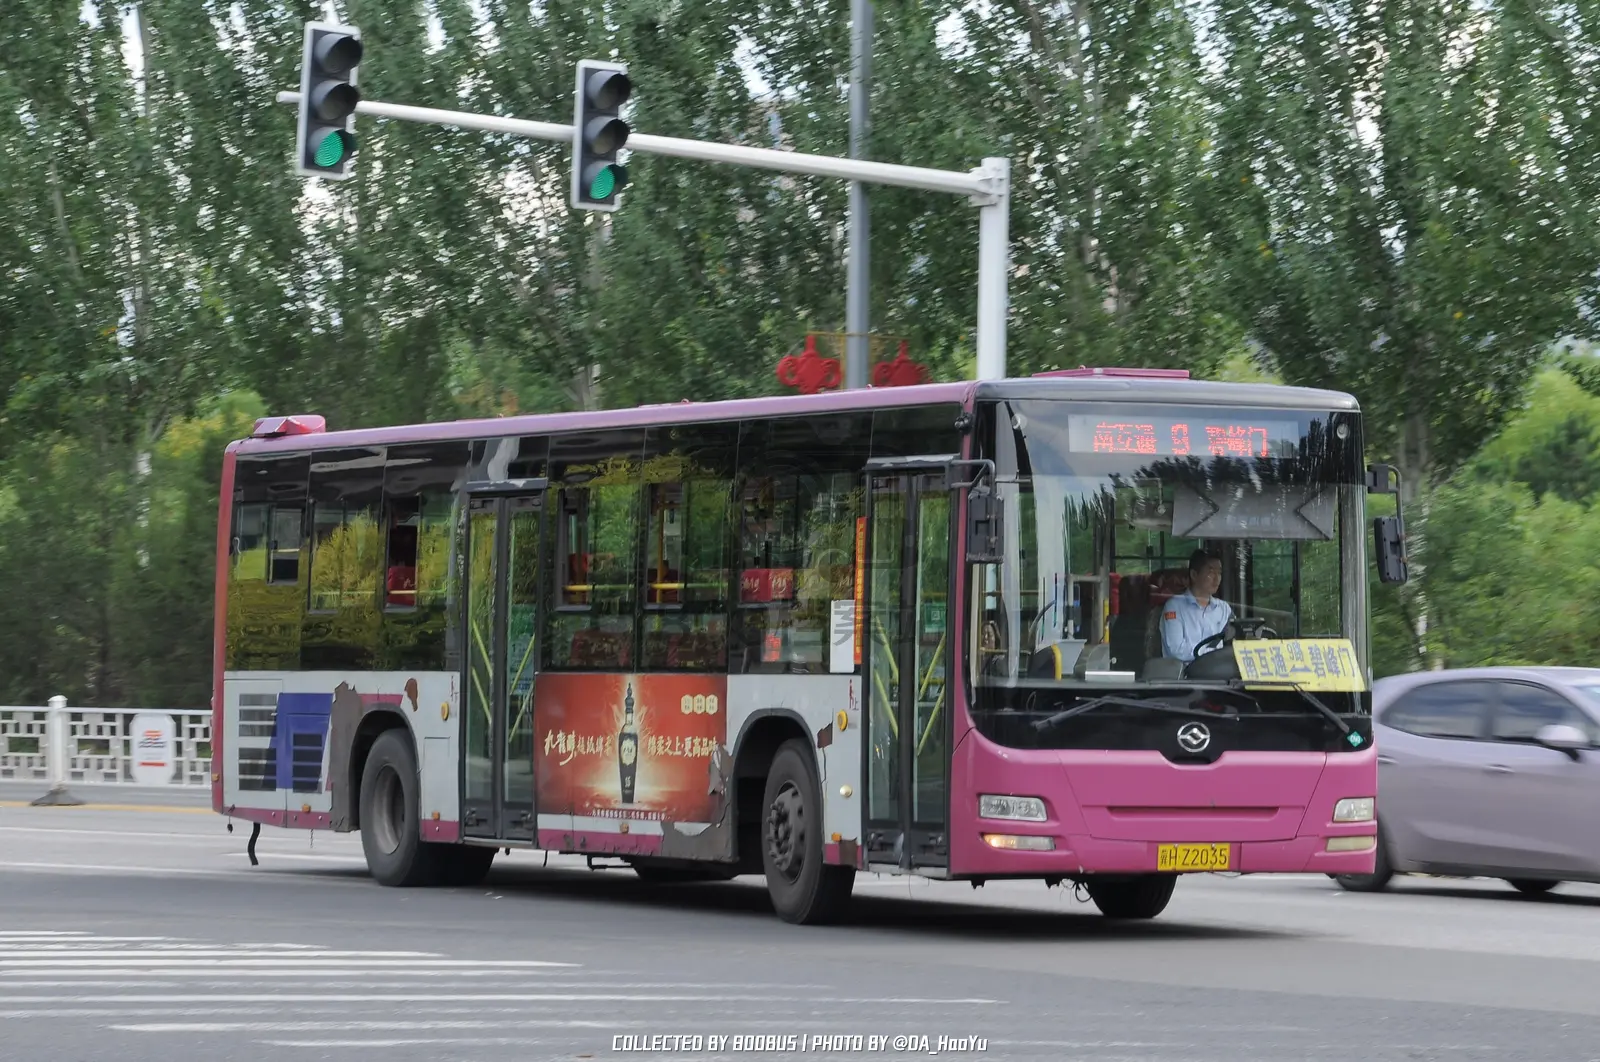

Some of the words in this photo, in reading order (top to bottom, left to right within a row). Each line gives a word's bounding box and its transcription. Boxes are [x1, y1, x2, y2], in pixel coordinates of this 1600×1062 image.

[1093, 421, 1157, 454] 南互通
[1170, 423, 1190, 455] 9
[1239, 646, 1290, 679] 南互通
[1286, 639, 1304, 662] 9路
[1307, 643, 1356, 679] 碧峰门
